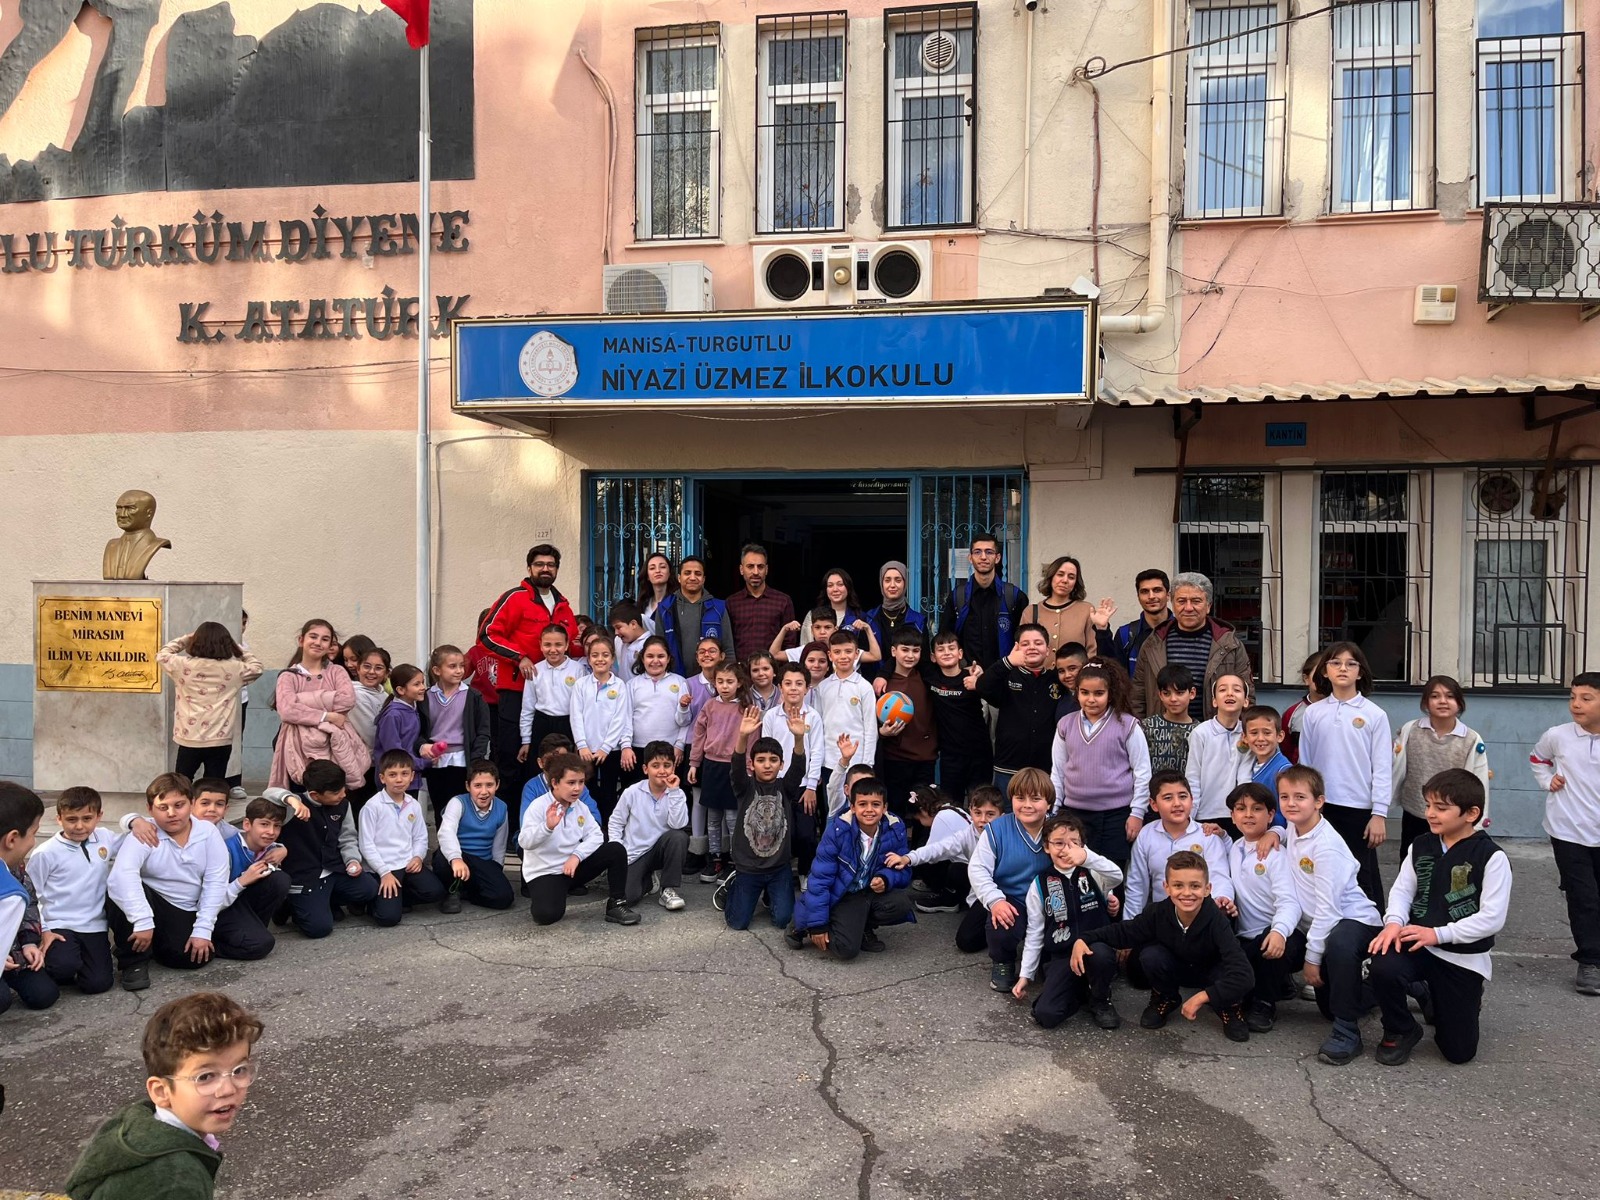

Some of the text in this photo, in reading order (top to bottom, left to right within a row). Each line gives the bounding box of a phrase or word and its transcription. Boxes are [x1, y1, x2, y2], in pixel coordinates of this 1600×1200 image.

[602, 363, 685, 391] NİYAZİ
[695, 362, 788, 390] ÜZMEZ
[799, 361, 954, 389] İLKOKULU
[54, 607, 143, 622] BENİM MANEVİ
[72, 626, 124, 640] MİRASIM
[47, 647, 149, 663] İLİM VE AKILDIR.
